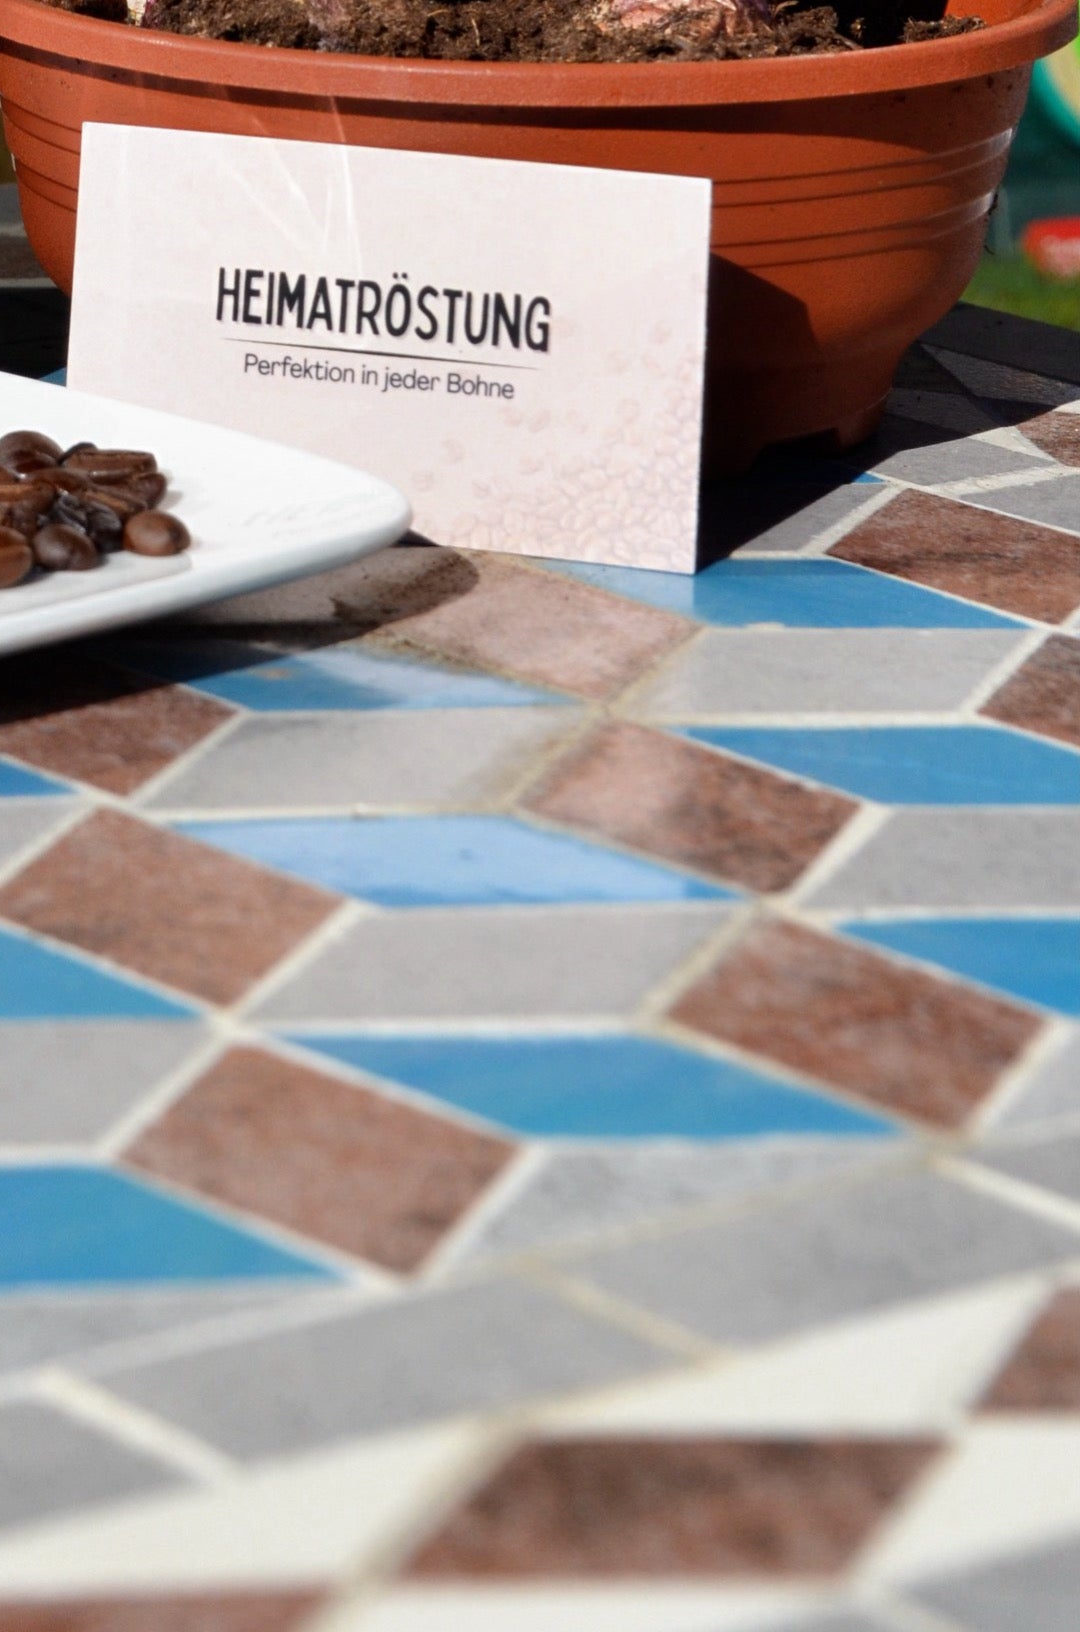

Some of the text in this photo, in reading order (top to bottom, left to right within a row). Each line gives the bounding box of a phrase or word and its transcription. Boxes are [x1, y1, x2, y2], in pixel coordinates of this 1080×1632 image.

[216, 267, 551, 353] HEIMATRÖSTUNG
[244, 353, 515, 400] Perfektion in jeder Bohne
